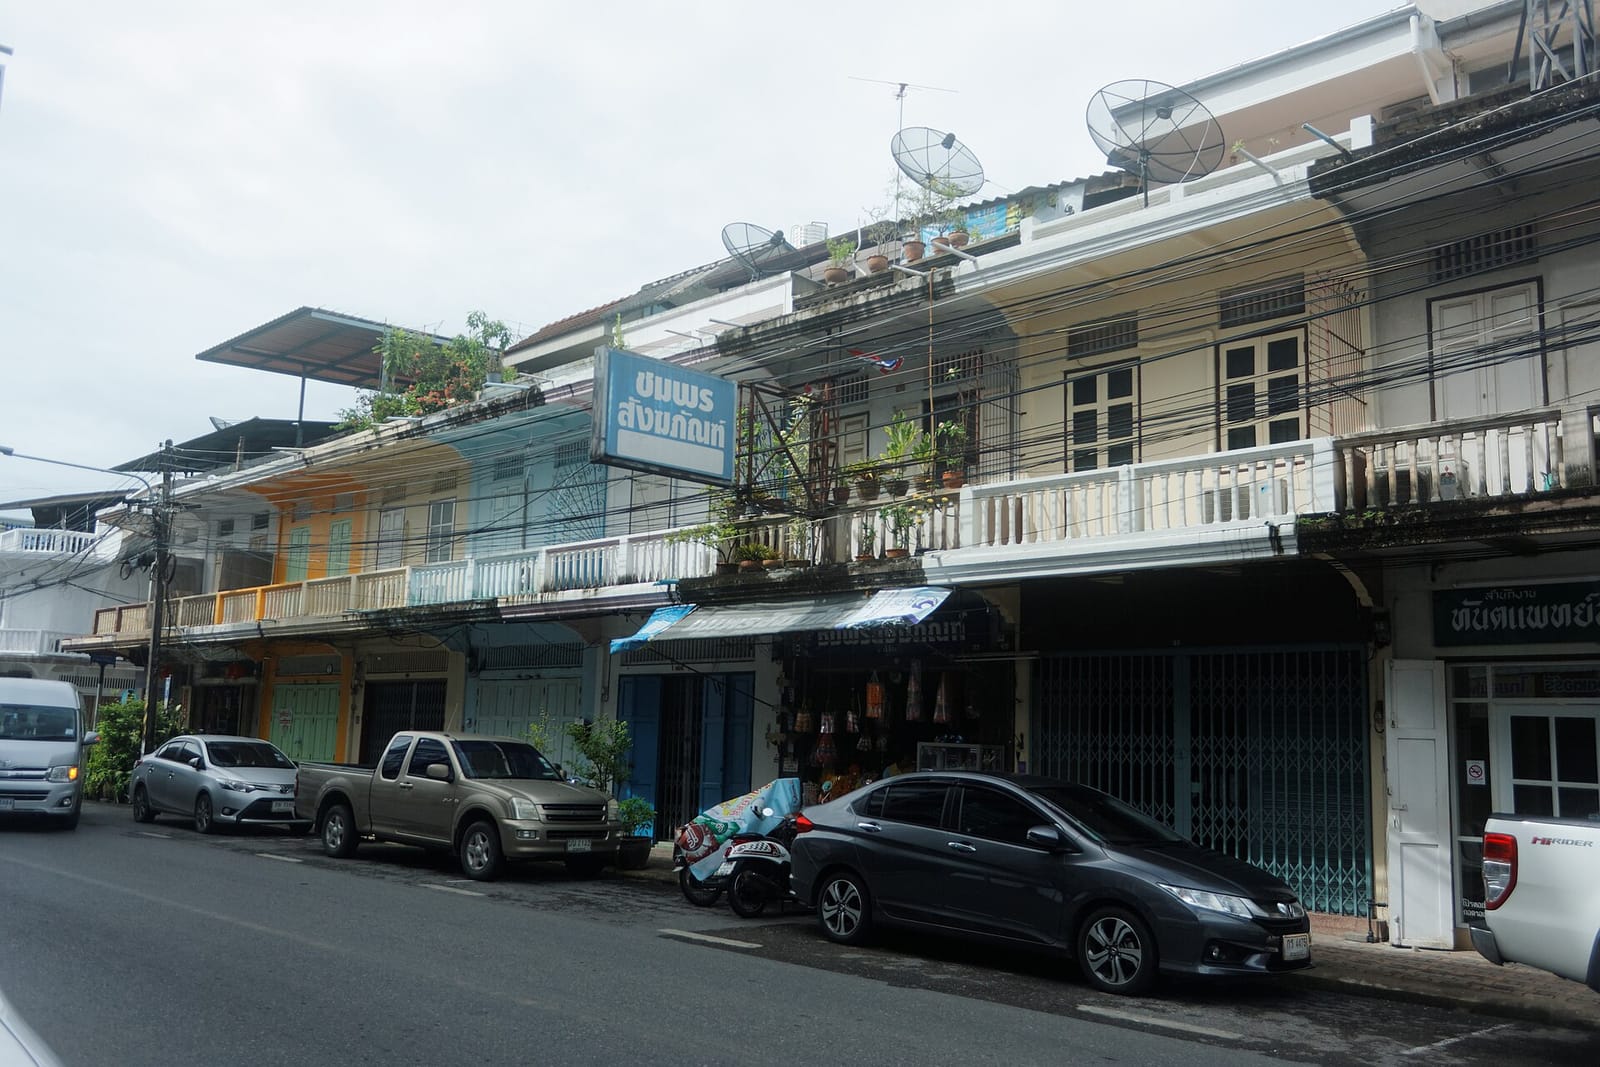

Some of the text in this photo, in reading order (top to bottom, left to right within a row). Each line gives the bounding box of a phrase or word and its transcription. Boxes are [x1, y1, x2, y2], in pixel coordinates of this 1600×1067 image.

[618, 397, 726, 448] สังฆภัณฑ์
[1451, 593, 1600, 631] ทันตแพทย์
[1485, 588, 1537, 601] สำนักงาน
